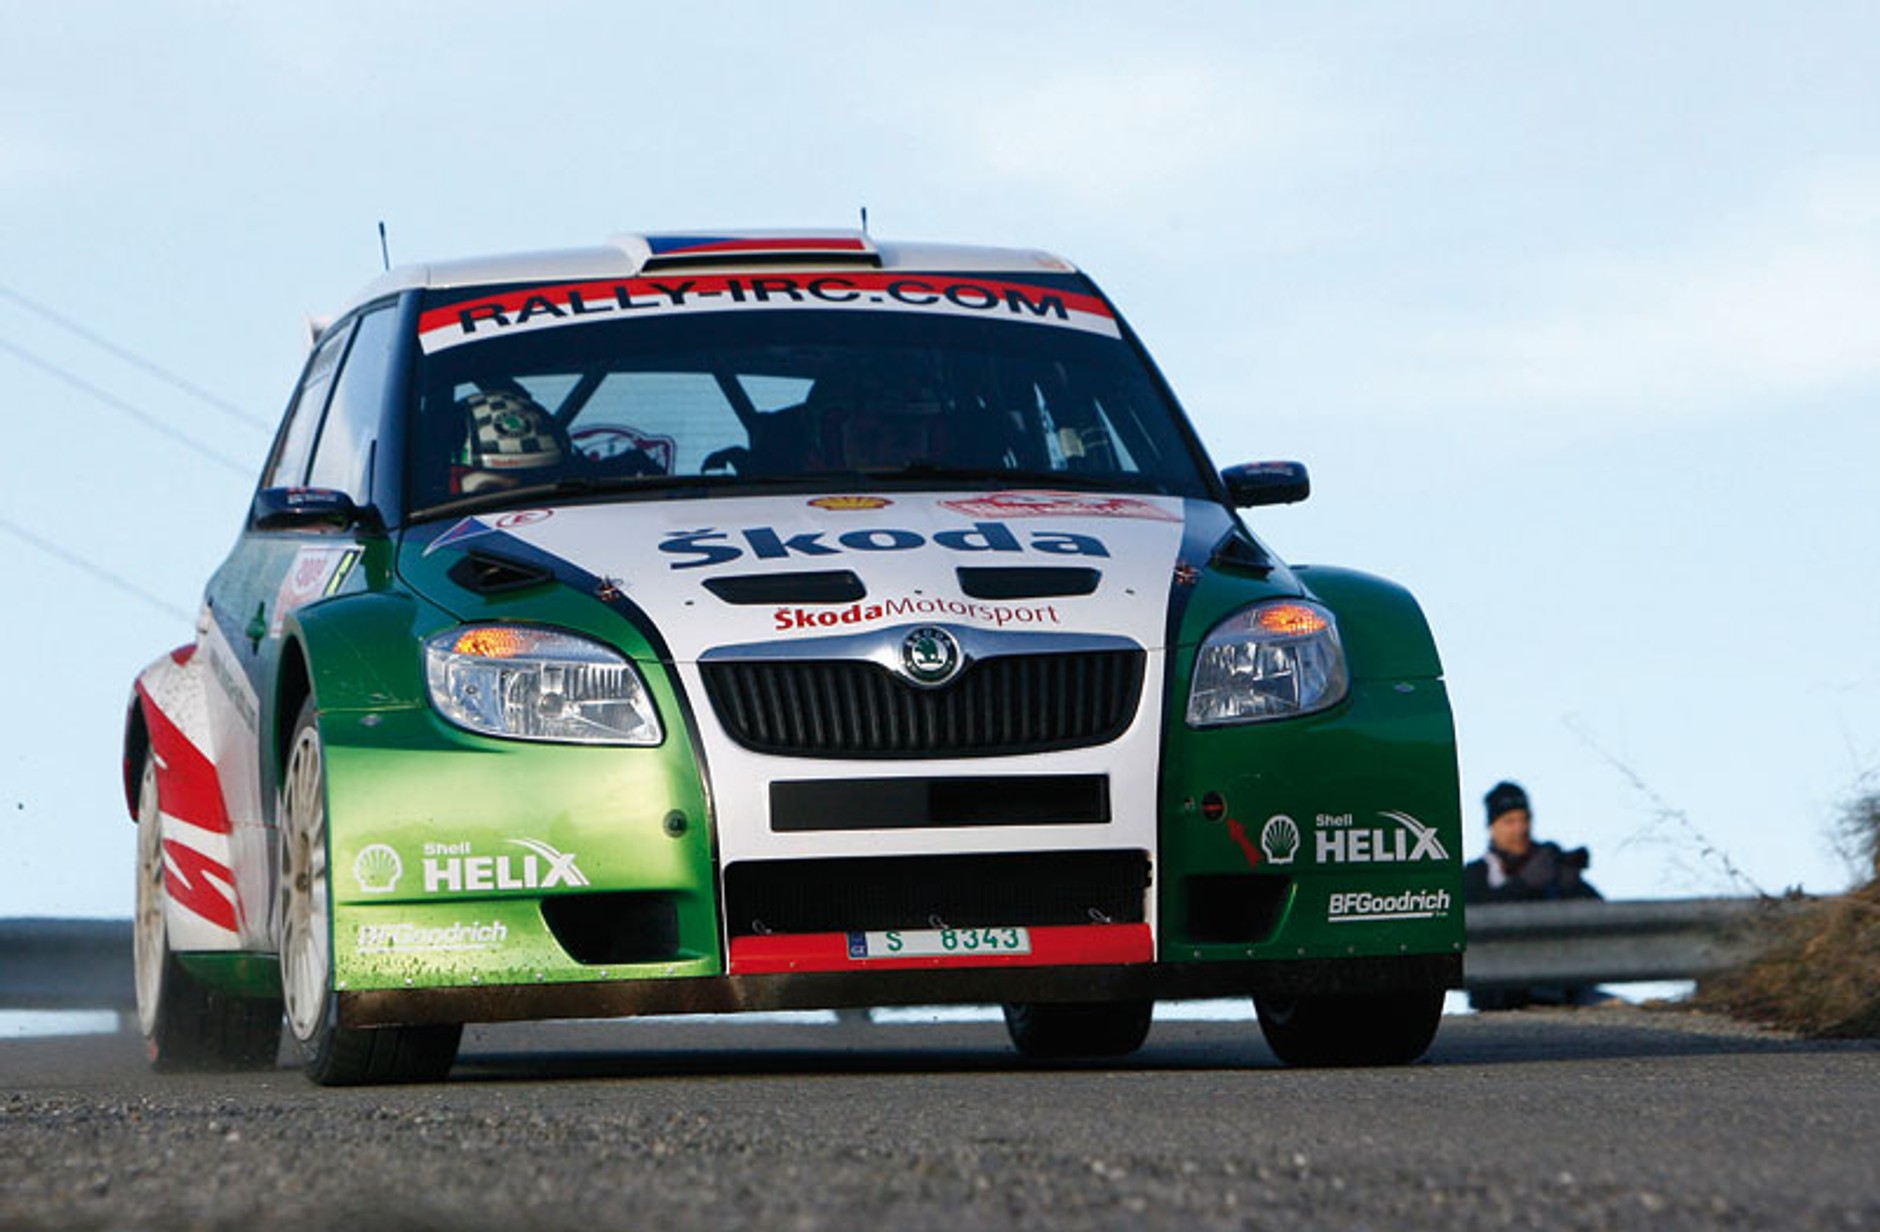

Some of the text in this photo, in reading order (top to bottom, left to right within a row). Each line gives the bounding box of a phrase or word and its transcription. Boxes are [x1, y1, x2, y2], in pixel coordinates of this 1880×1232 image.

[460, 277, 1070, 334] RALLY-IRC.COM
[658, 523, 1110, 569] Škoda
[1315, 810, 1449, 863] HELIX
[1316, 814, 1353, 827] Shell
[423, 842, 471, 855] Shell
[423, 838, 590, 892] HELIX
[1329, 890, 1450, 914] BFGoodrich
[886, 927, 1019, 951] S 8343
